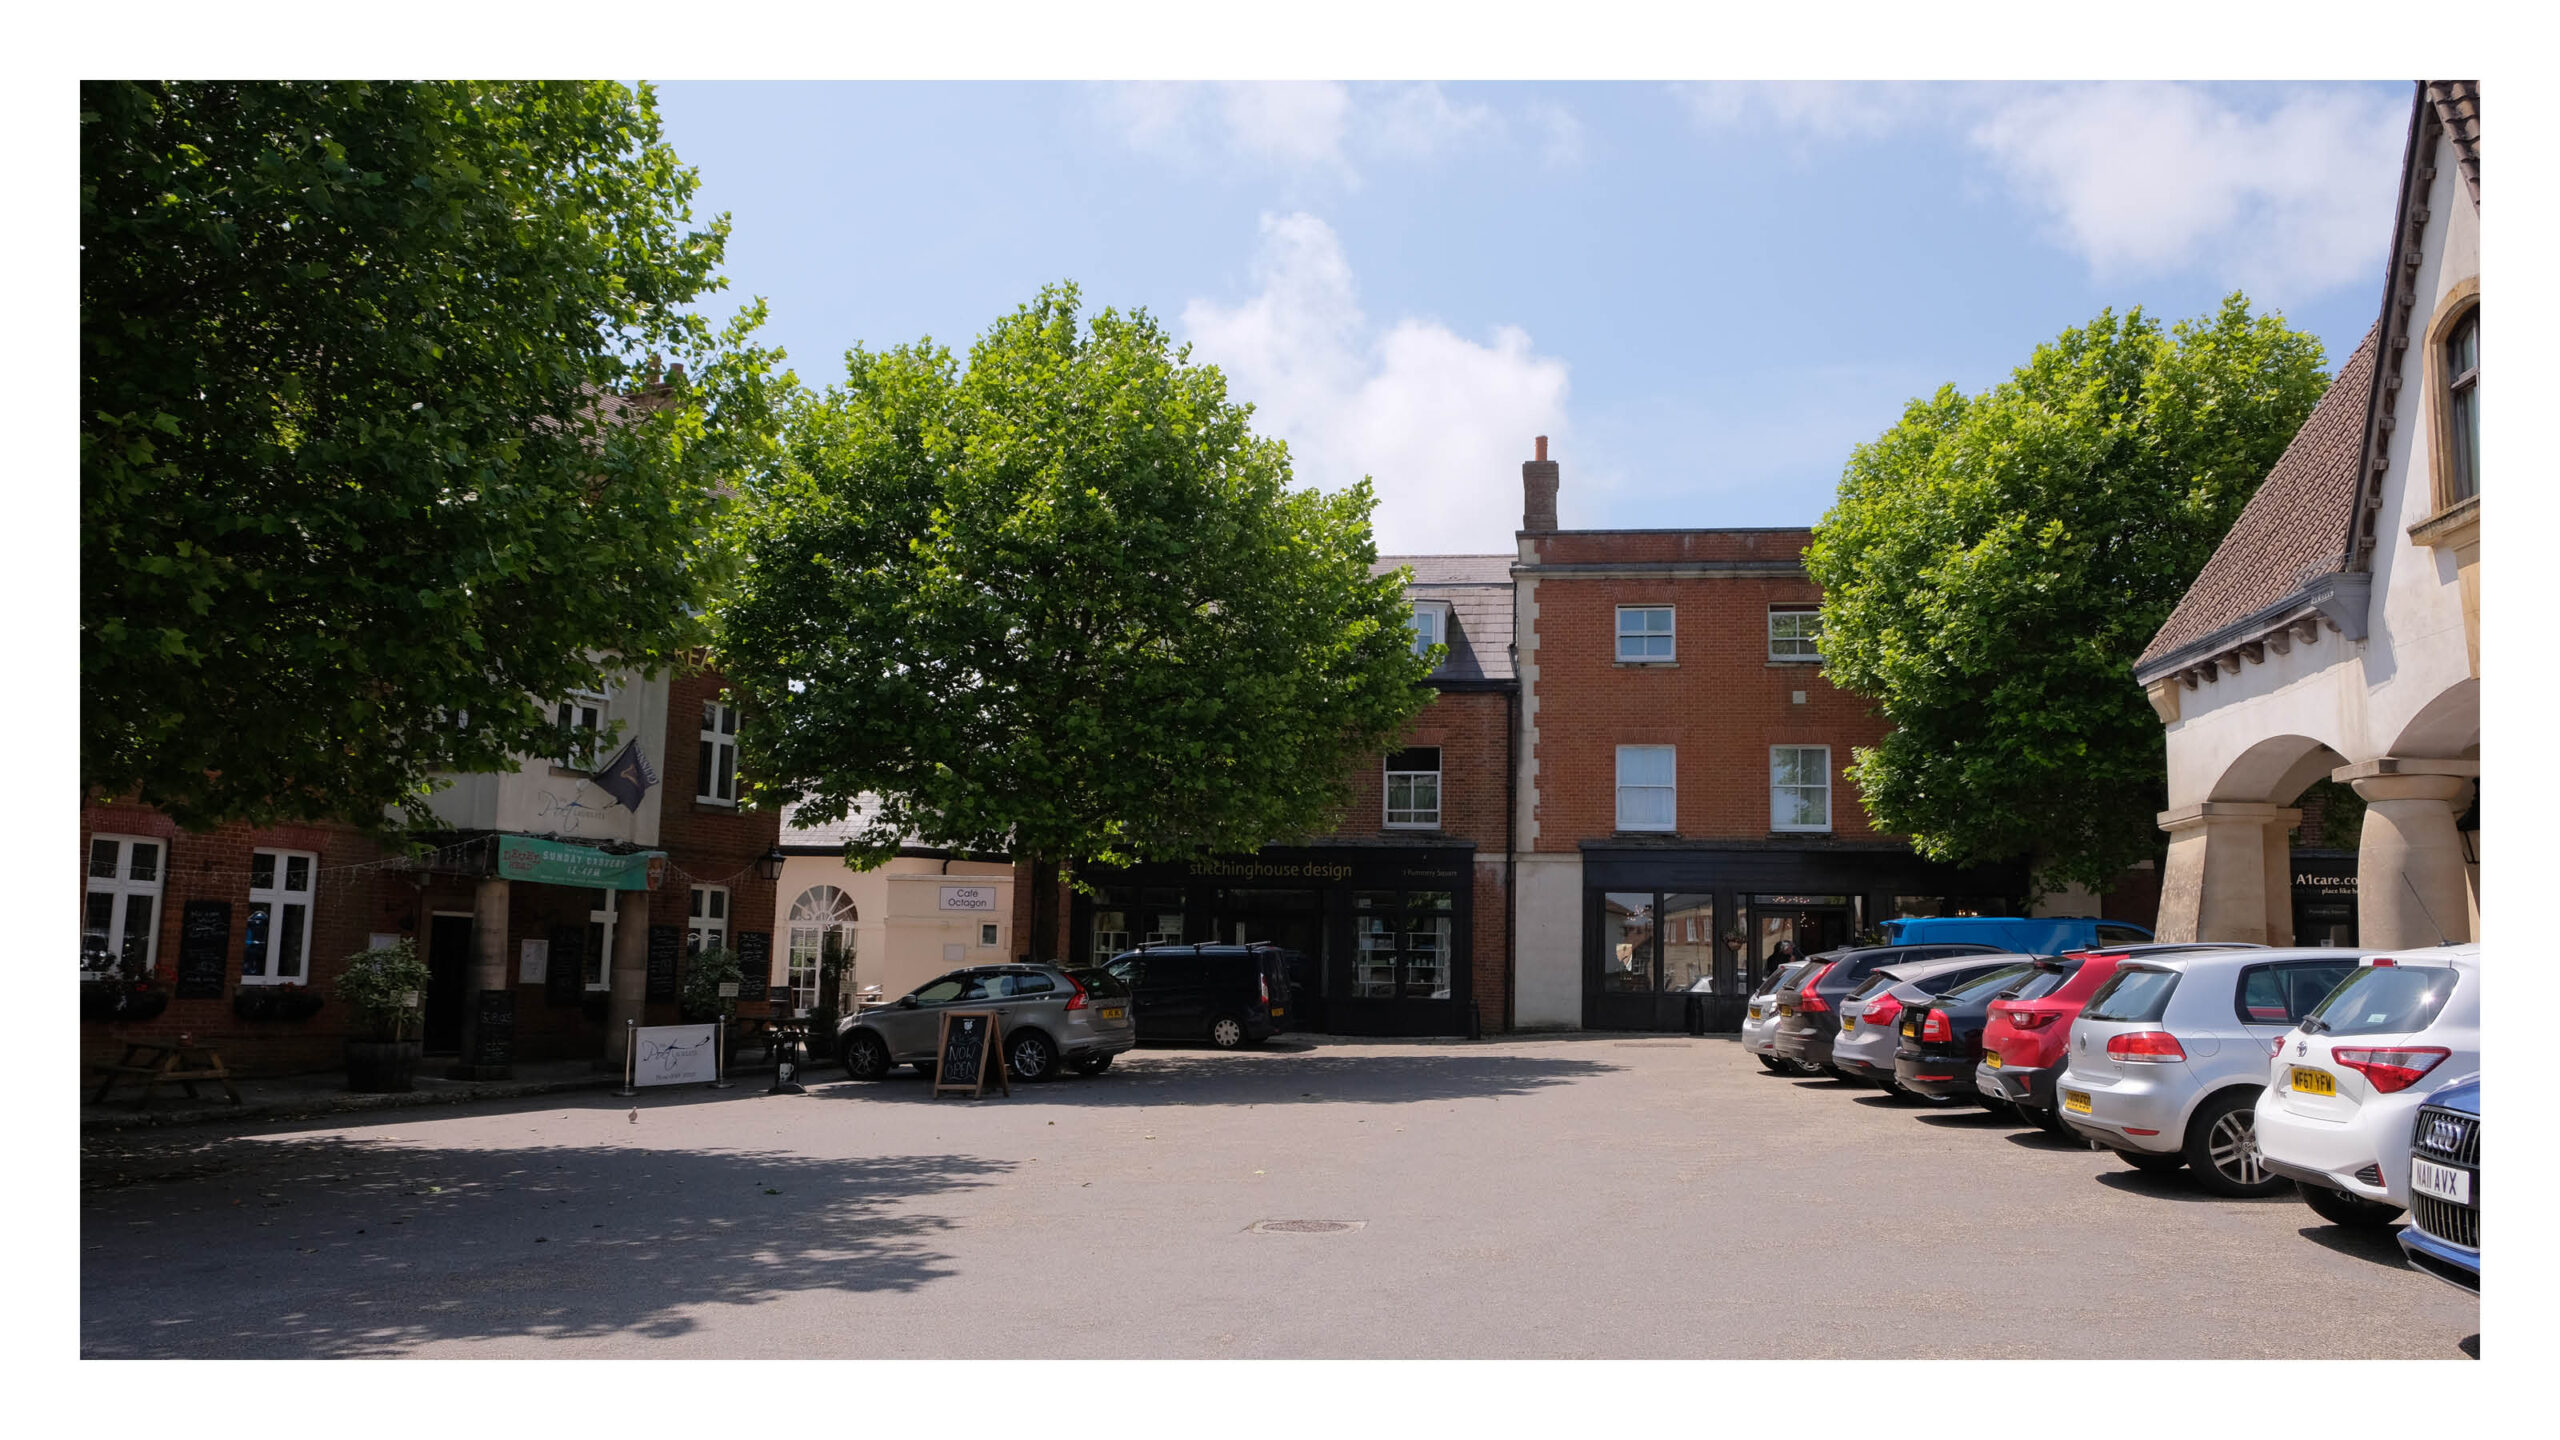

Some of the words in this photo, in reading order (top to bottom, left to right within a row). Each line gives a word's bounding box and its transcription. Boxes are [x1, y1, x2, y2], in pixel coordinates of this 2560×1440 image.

[542, 850, 583, 865] SUNDAY
[586, 857, 627, 869] CARVERY
[1189, 860, 1299, 880] stitchinghouse
[1303, 861, 1352, 881] design
[1437, 867, 1458, 877] Square
[2321, 888, 2338, 896] place
[2339, 887, 2351, 895] like
[947, 898, 987, 908] Octagon
[948, 1045, 978, 1061] NOW
[944, 1060, 977, 1080] OPEN
[2293, 1071, 2313, 1090] WF67
[2314, 1073, 2332, 1092] YFW
[2434, 1167, 2457, 1196] AVX
